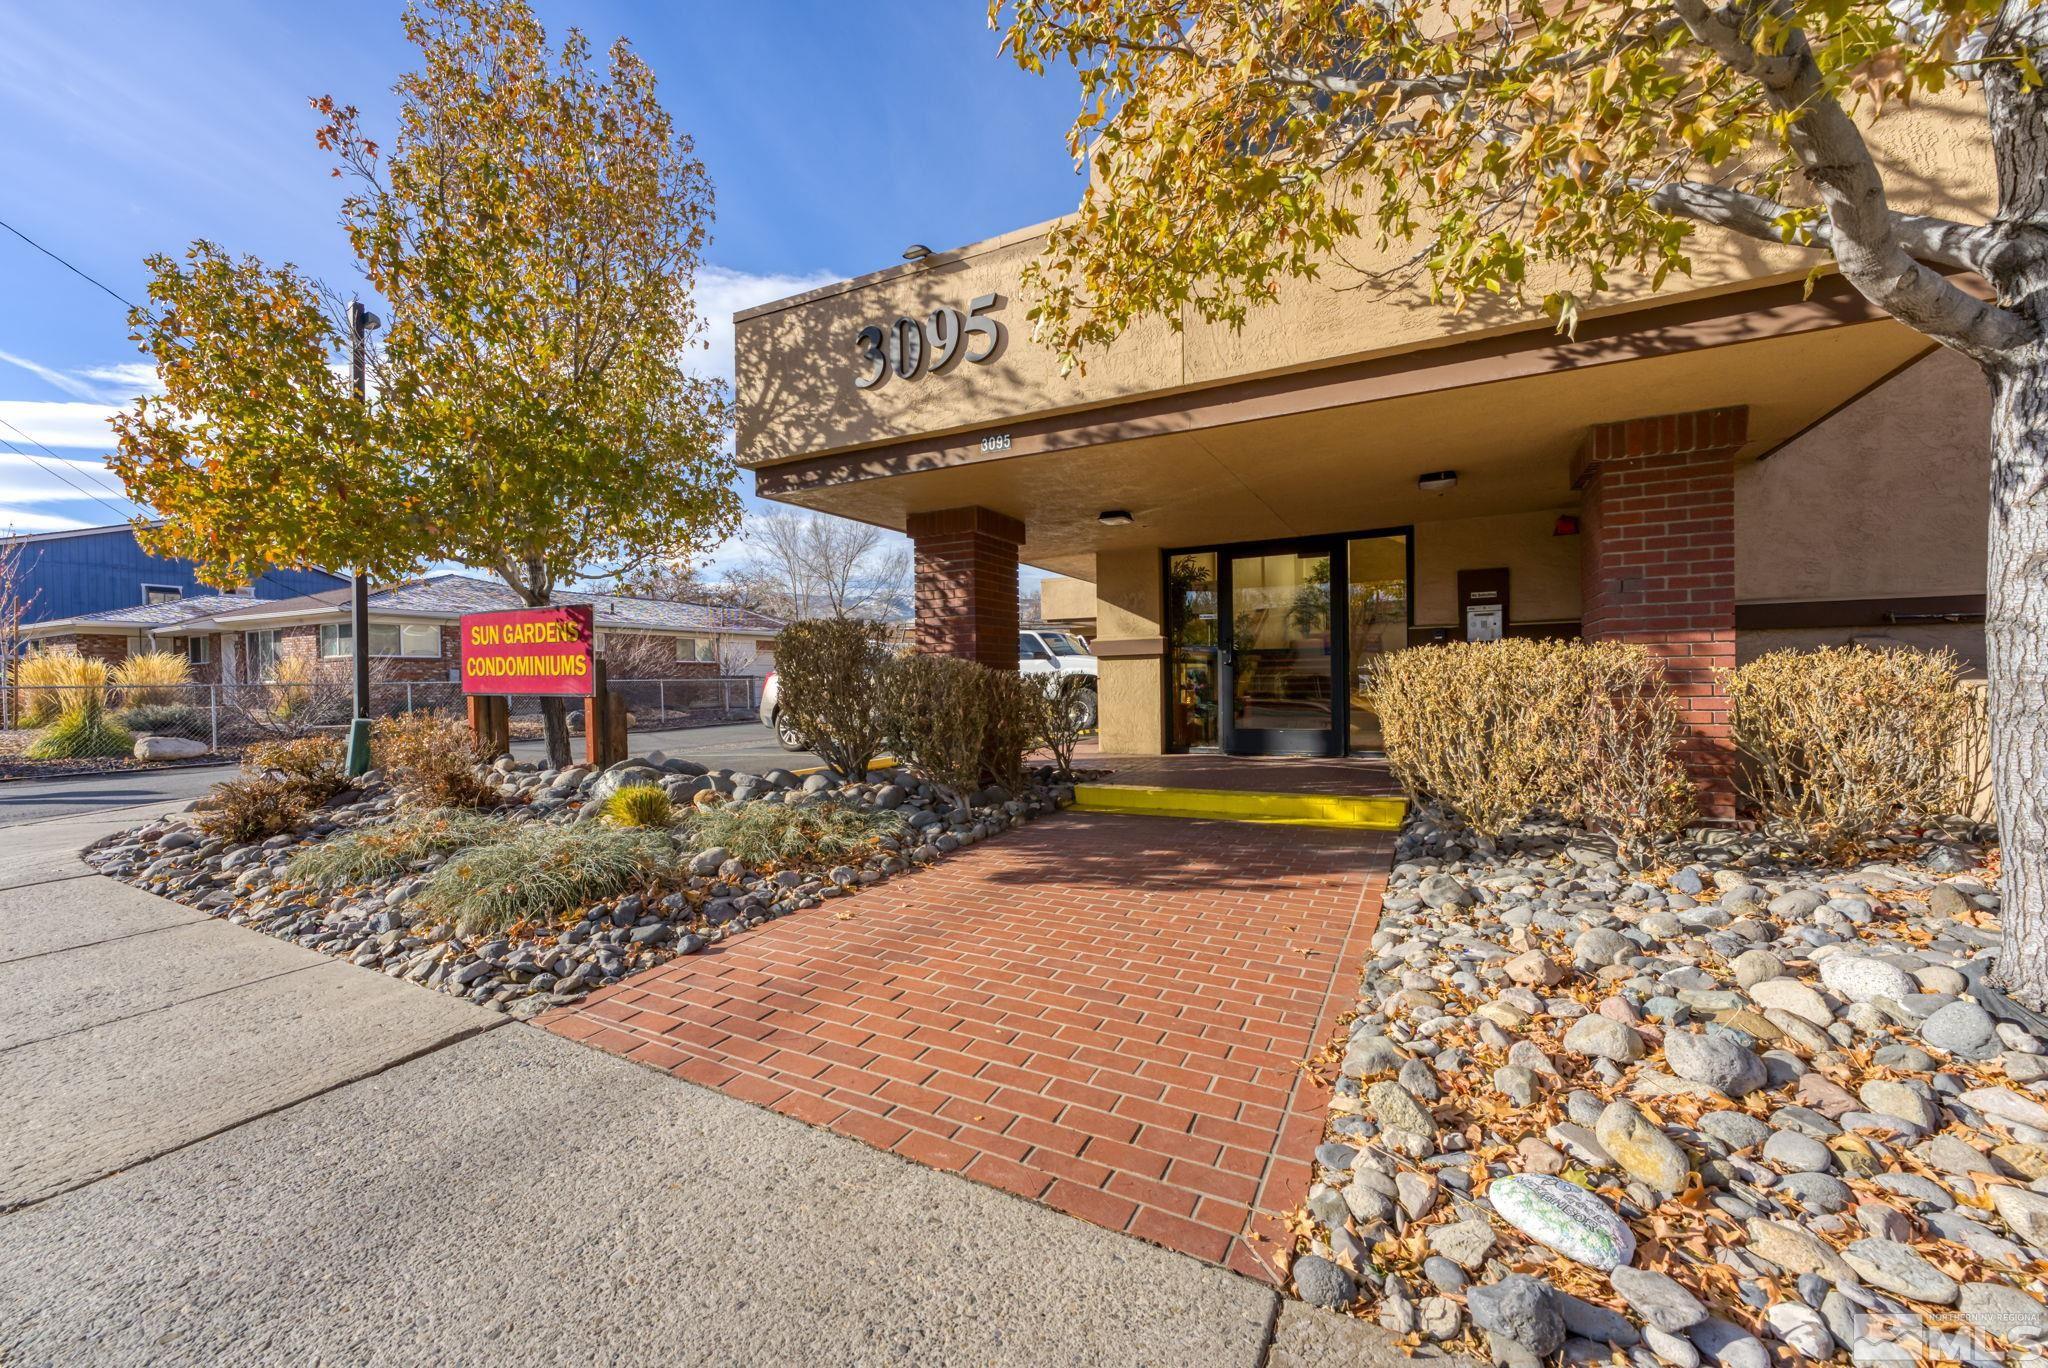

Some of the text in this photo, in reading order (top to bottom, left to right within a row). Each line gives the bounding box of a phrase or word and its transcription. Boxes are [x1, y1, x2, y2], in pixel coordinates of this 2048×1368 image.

[855, 293, 999, 388] 3095
[981, 434, 1012, 452] 3095
[471, 621, 580, 645] SUN GARDENS
[467, 655, 587, 676] CONDOMINIUMS
